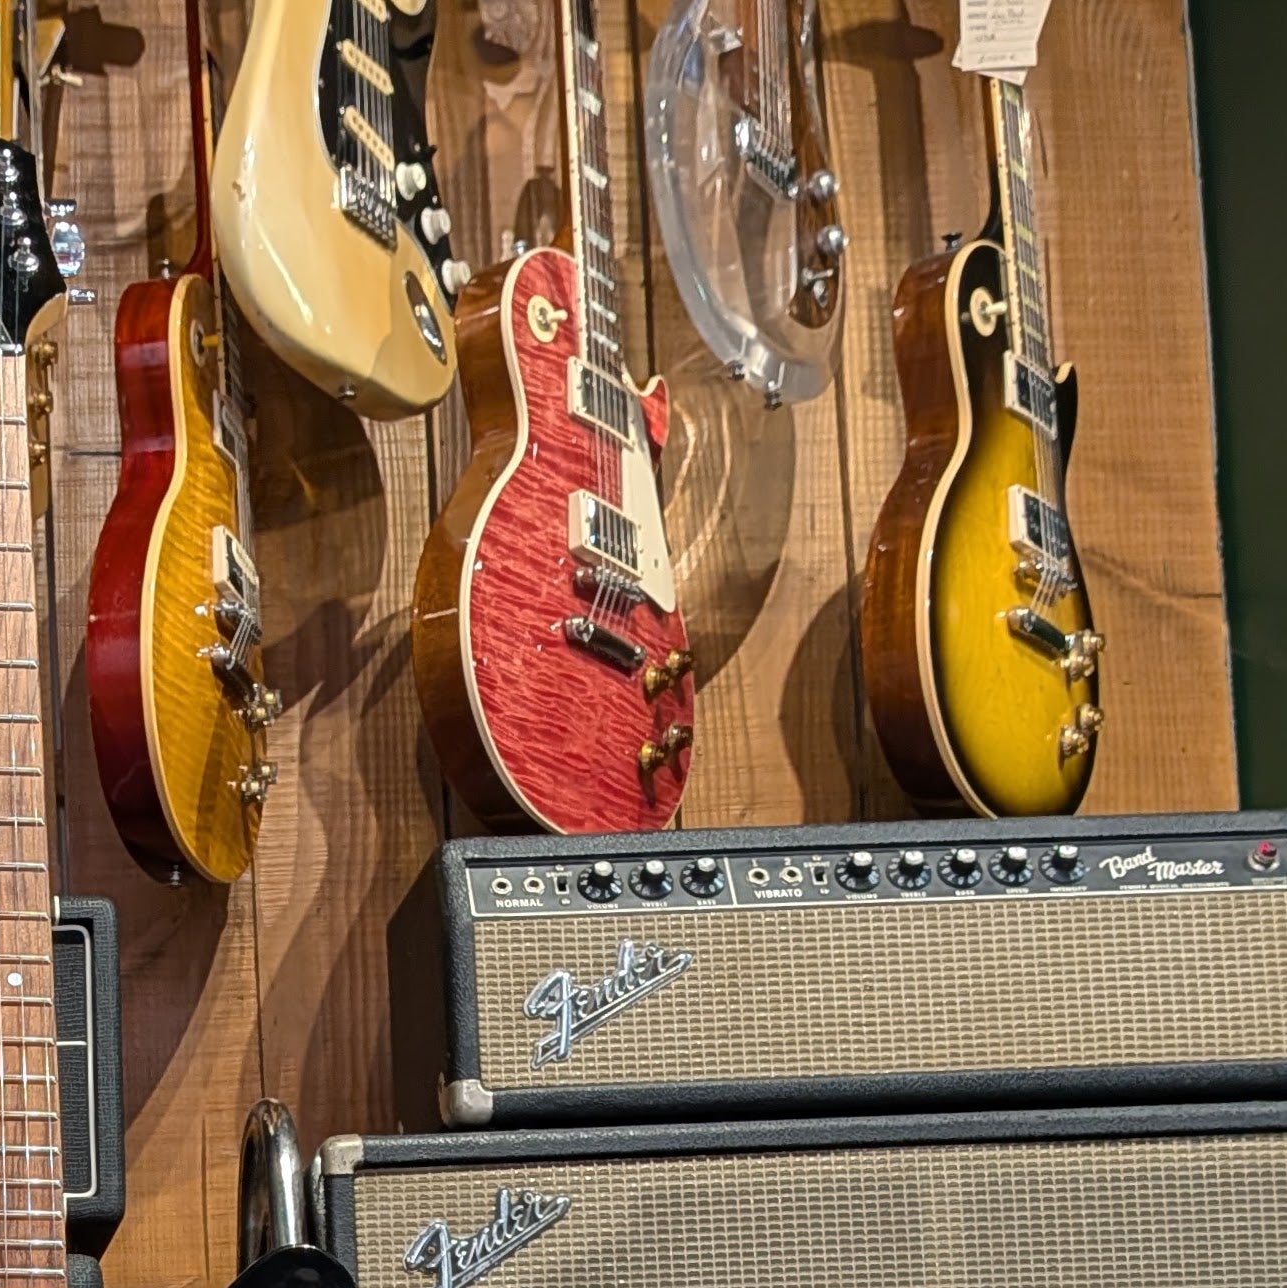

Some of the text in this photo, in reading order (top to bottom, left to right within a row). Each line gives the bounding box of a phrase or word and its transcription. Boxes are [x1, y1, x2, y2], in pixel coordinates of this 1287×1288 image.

[1099, 845, 1225, 881] Band Master
[496, 899, 544, 908] NORMAL
[754, 889, 802, 898] VIBRATO
[524, 938, 693, 1069] Fender
